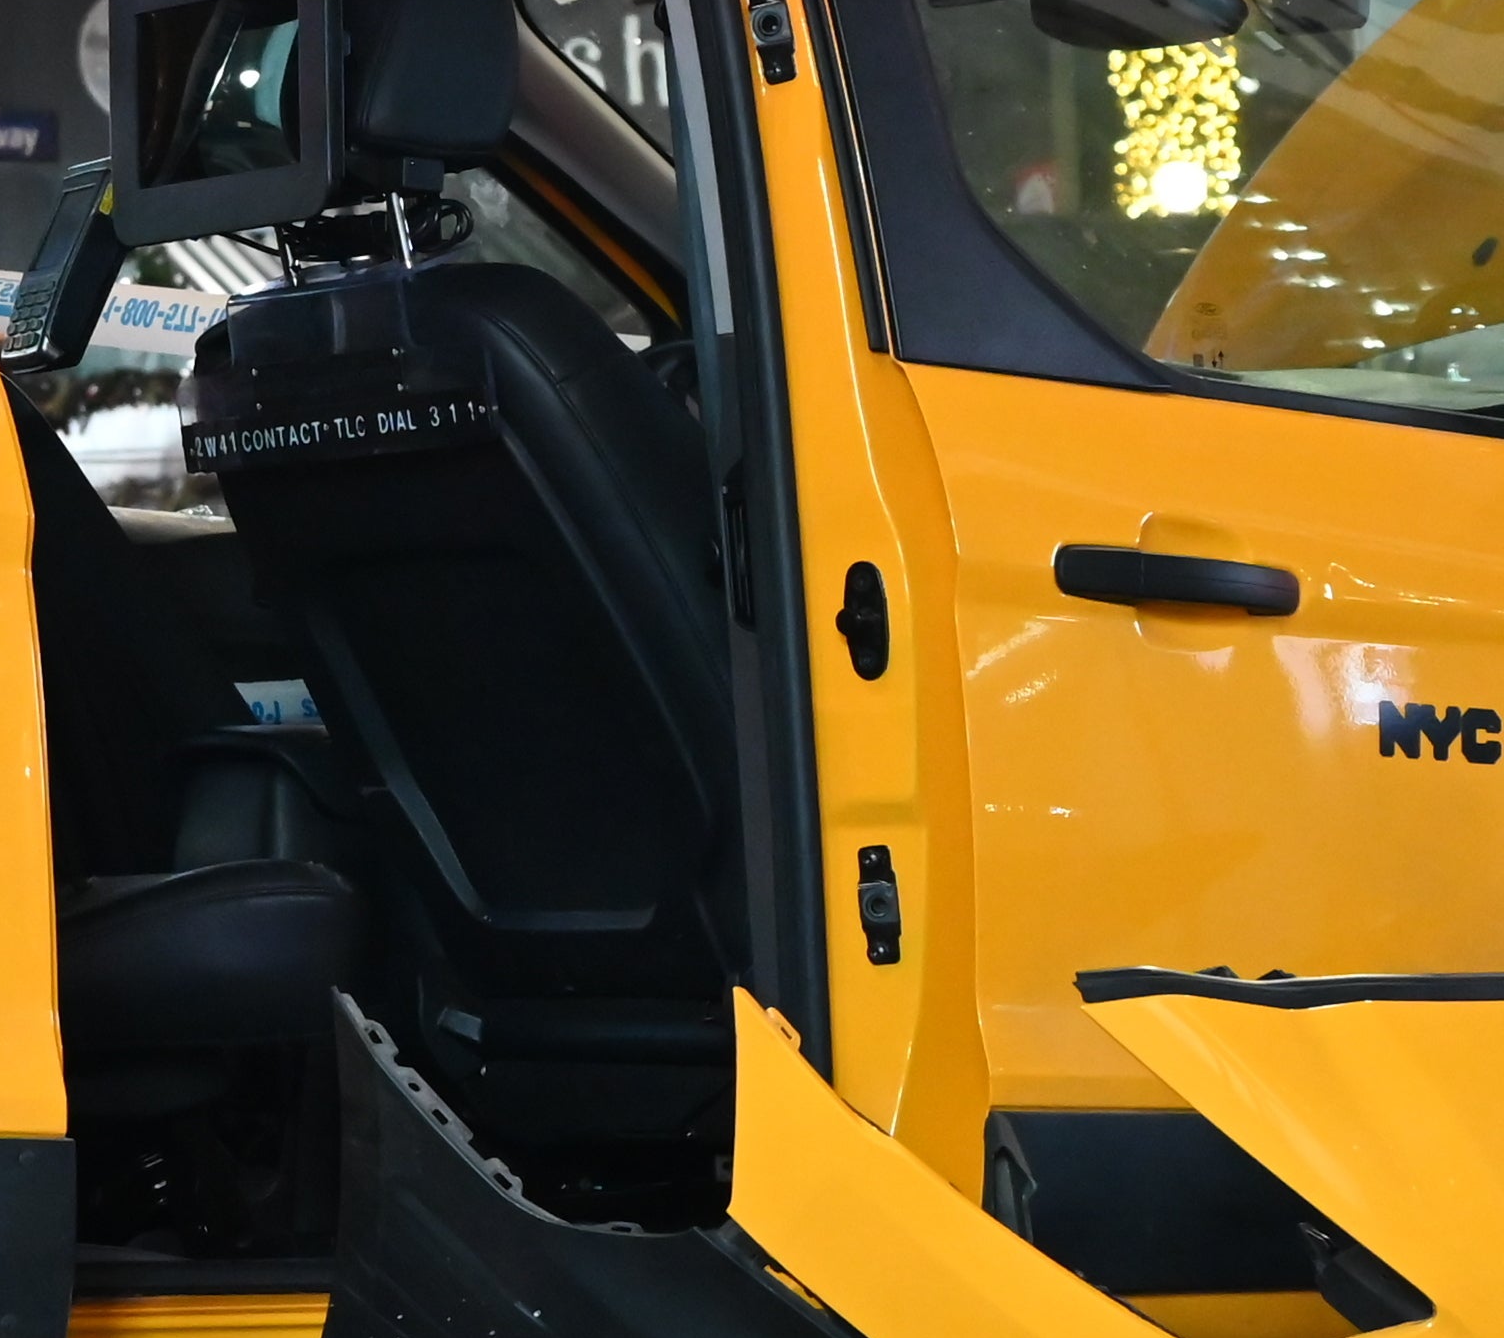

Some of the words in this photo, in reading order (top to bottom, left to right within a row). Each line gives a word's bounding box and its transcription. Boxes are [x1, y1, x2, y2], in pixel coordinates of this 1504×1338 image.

[241, 421, 321, 453] CONTACT
[334, 414, 366, 439] TLC
[378, 408, 418, 434] DIAL
[1377, 699, 1503, 768] NYC
